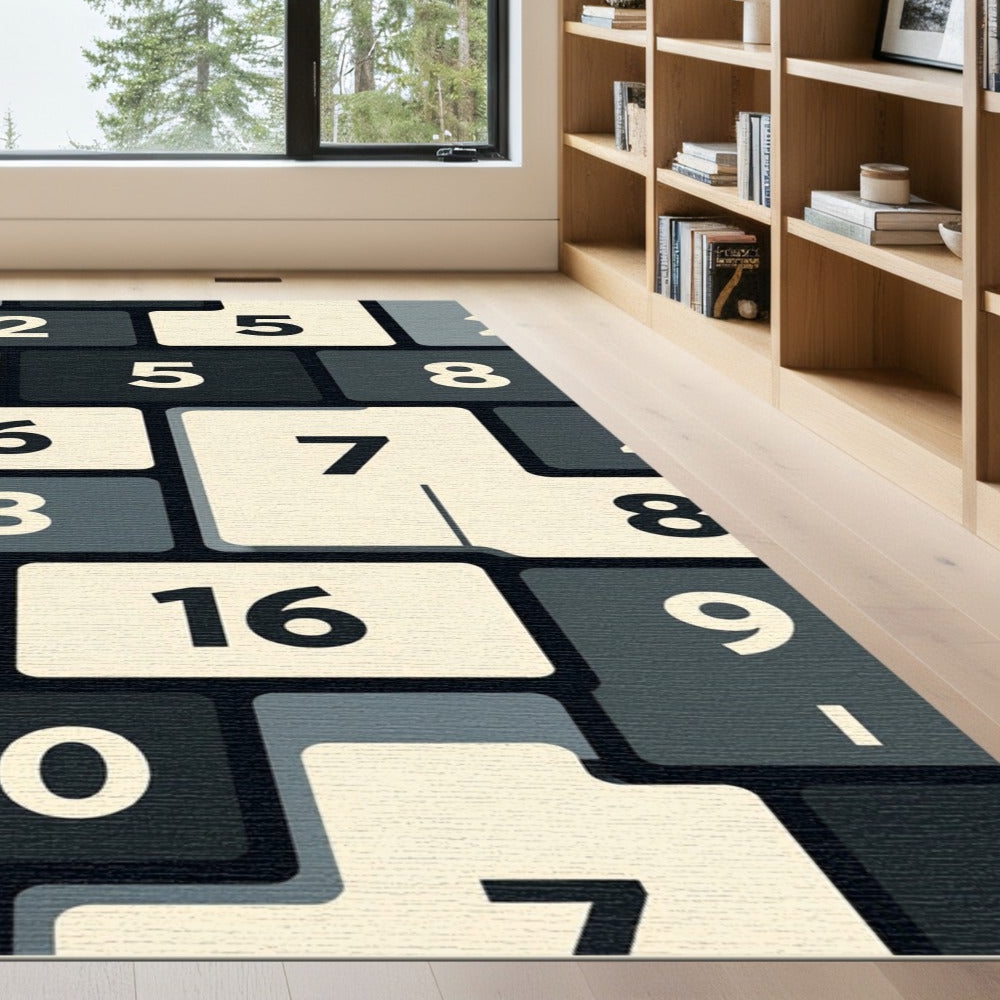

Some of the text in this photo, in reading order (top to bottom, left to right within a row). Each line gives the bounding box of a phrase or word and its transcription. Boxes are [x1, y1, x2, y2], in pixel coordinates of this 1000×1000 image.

[236, 315, 303, 336] 5
[128, 362, 205, 388] 5
[423, 362, 511, 388] 8
[295, 436, 390, 475] 7
[612, 493, 730, 538] 8
[152, 586, 368, 648] 16
[663, 592, 795, 656] 9
